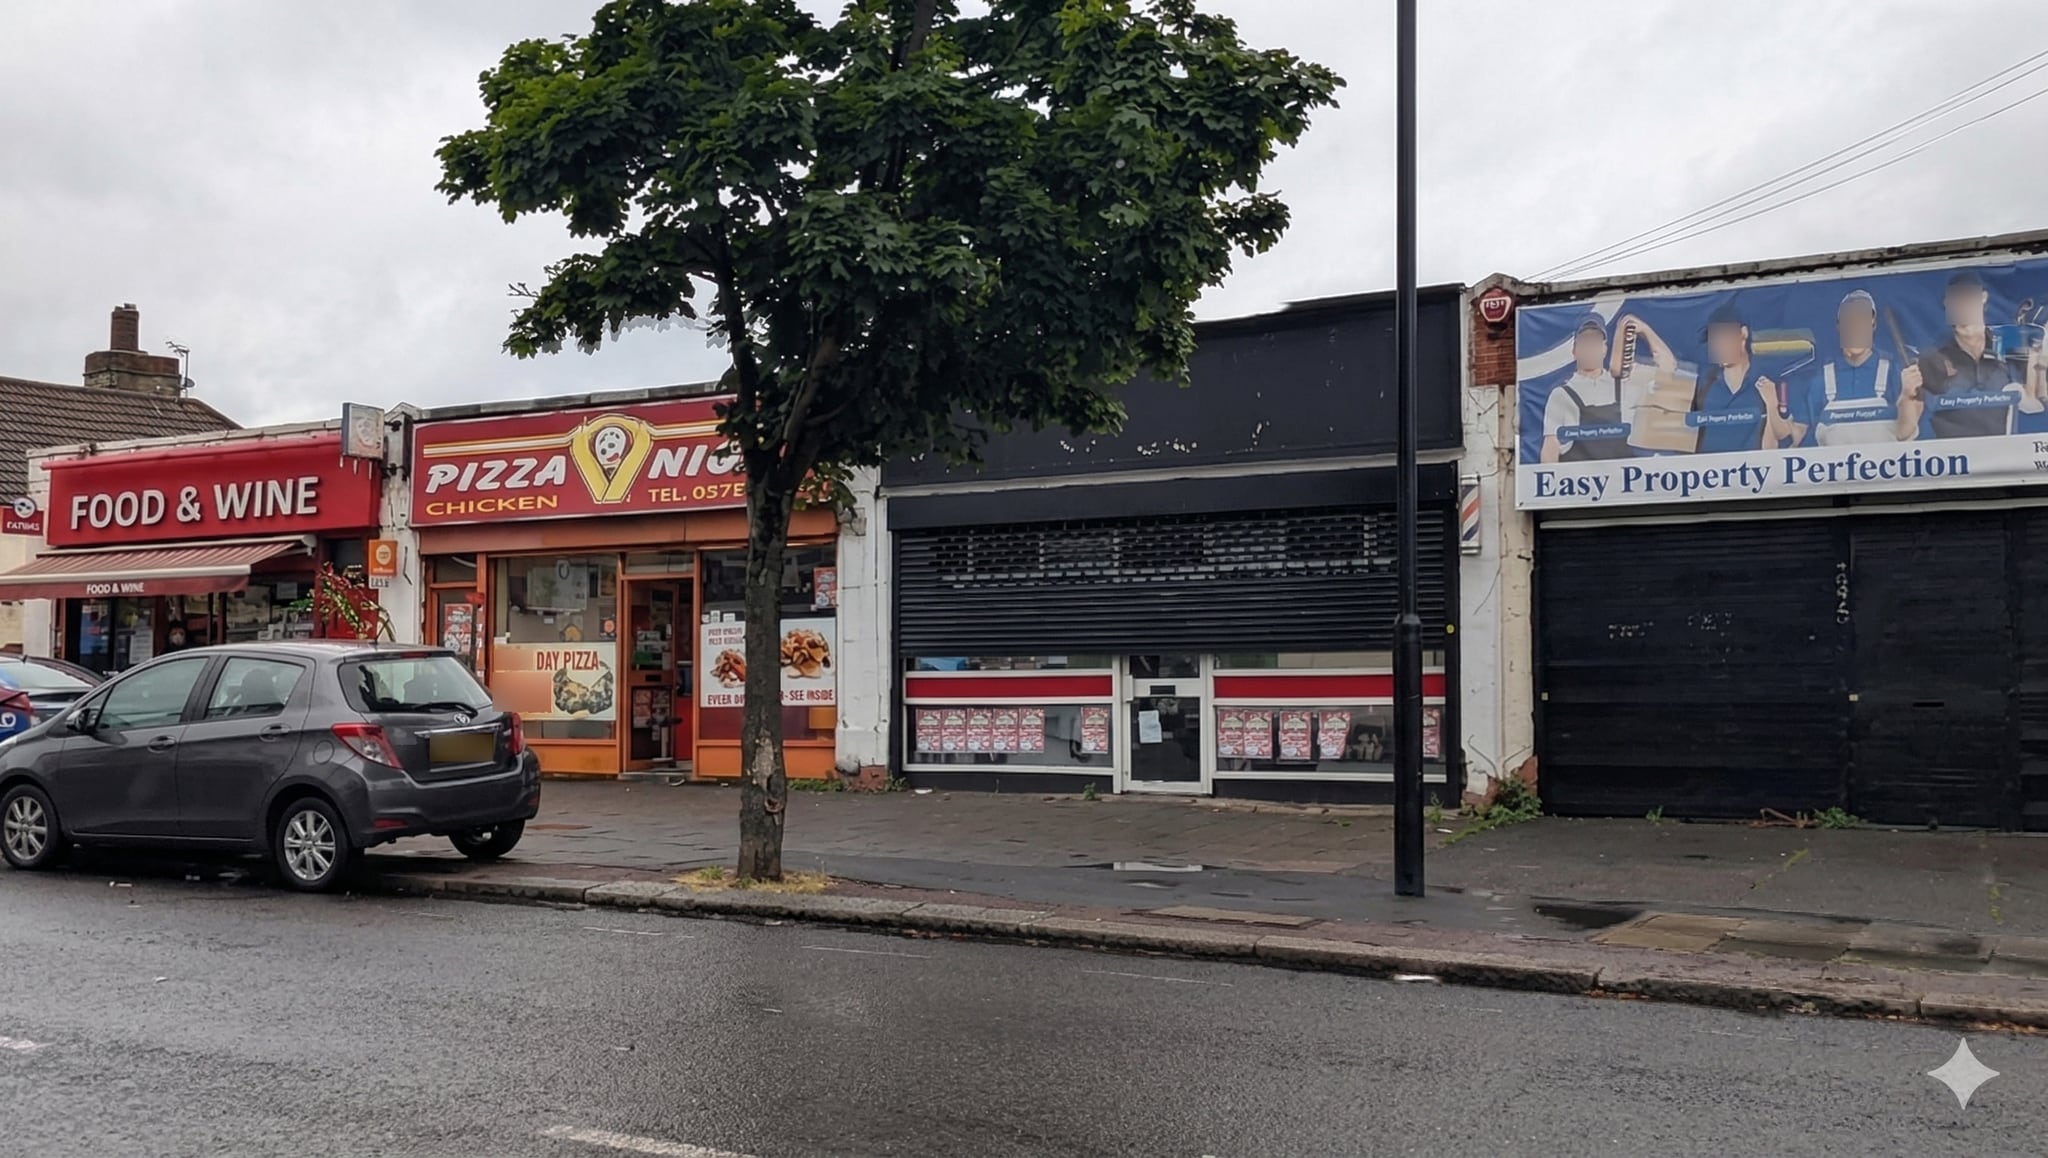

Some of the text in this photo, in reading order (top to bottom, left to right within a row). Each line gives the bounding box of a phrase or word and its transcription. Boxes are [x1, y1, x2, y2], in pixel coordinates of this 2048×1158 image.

[425, 455, 566, 494] PIZZA
[1534, 449, 1970, 502] Easy Property Perfection
[71, 476, 319, 530] FOOD & WINE
[648, 487, 687, 502] TEL.
[425, 495, 558, 516] CHICKEN
[86, 583, 110, 594] FOOD
[121, 582, 144, 593] WINE
[537, 651, 599, 670] DAY PIZZA
[790, 690, 804, 700] SEE
[806, 689, 833, 700] INSIDE
